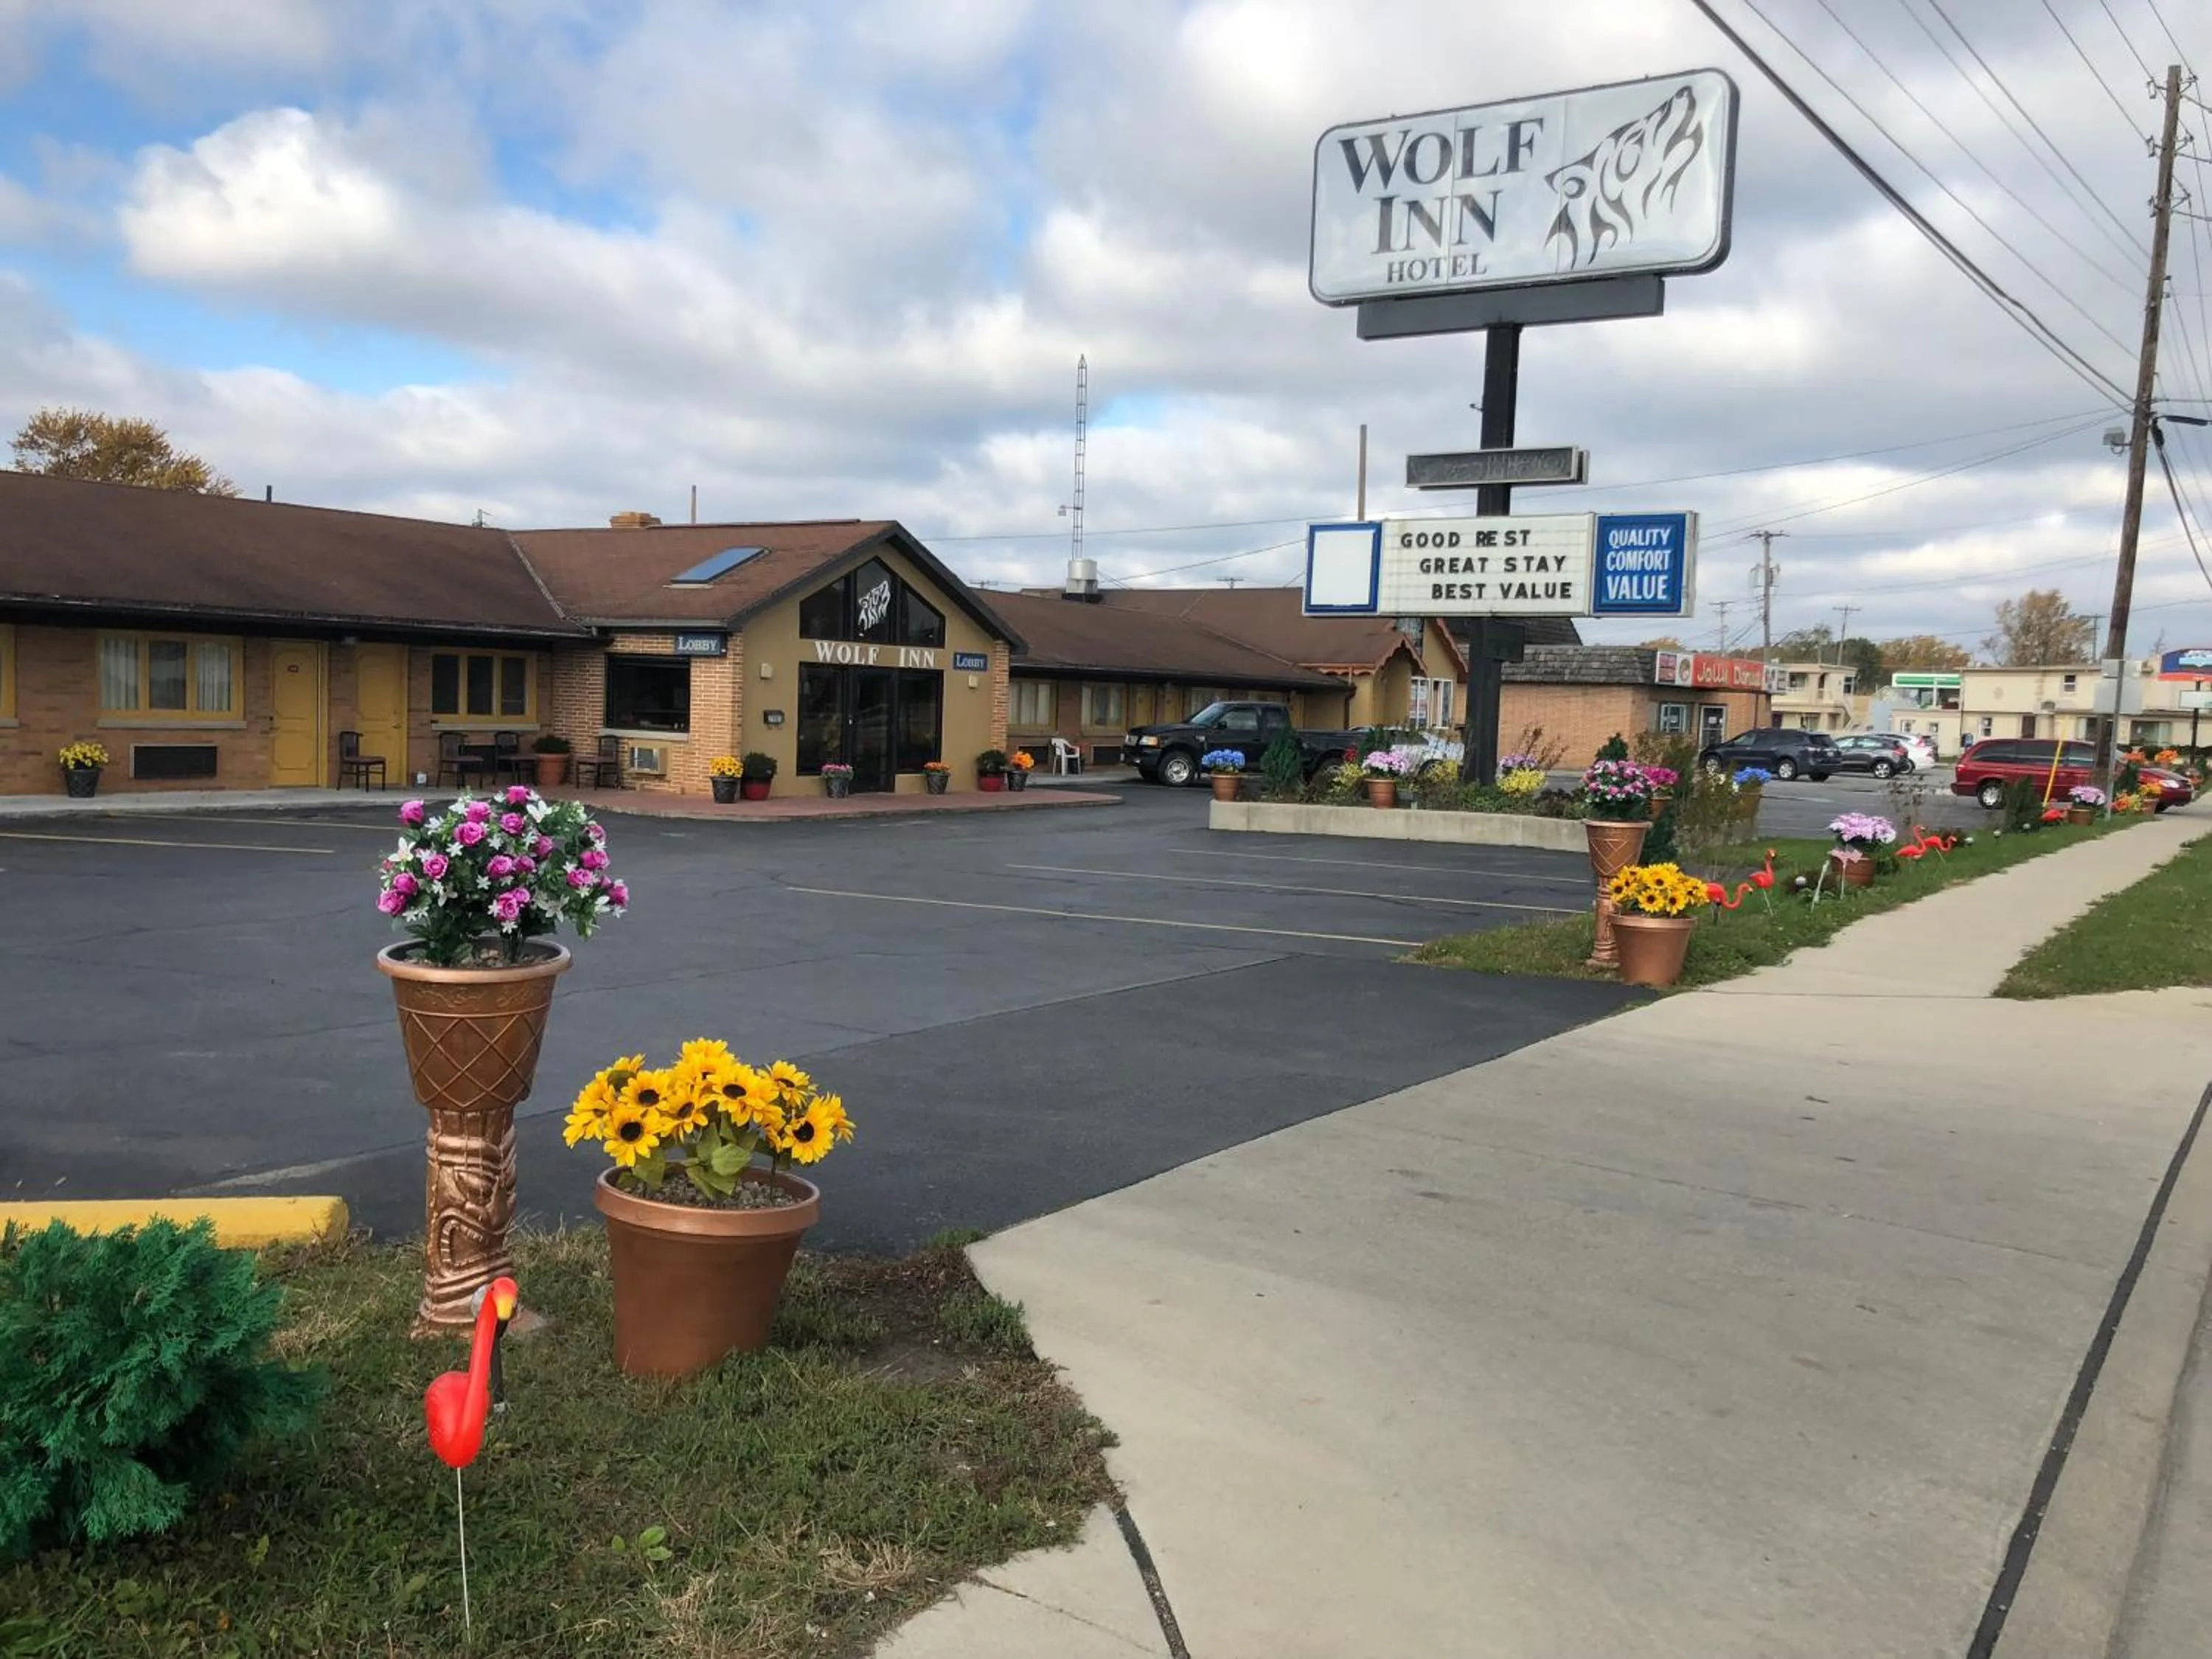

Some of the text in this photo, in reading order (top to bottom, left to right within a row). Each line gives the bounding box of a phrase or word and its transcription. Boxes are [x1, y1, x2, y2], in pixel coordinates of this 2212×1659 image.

[1338, 117, 1544, 194] WOLF
[1371, 189, 1503, 254] INN
[1387, 252, 1487, 283] HOTEL
[1401, 529, 1531, 548] GOOD REST
[1608, 526, 1672, 549] QUALITY
[1419, 555, 1566, 574] GREAT STAY
[1606, 549, 1673, 571] COMFORT
[1431, 582, 1572, 599] BEST VALUE
[1606, 574, 1669, 599] VALUE
[678, 636, 718, 650] LOBBY
[814, 639, 935, 668] WOLF INN
